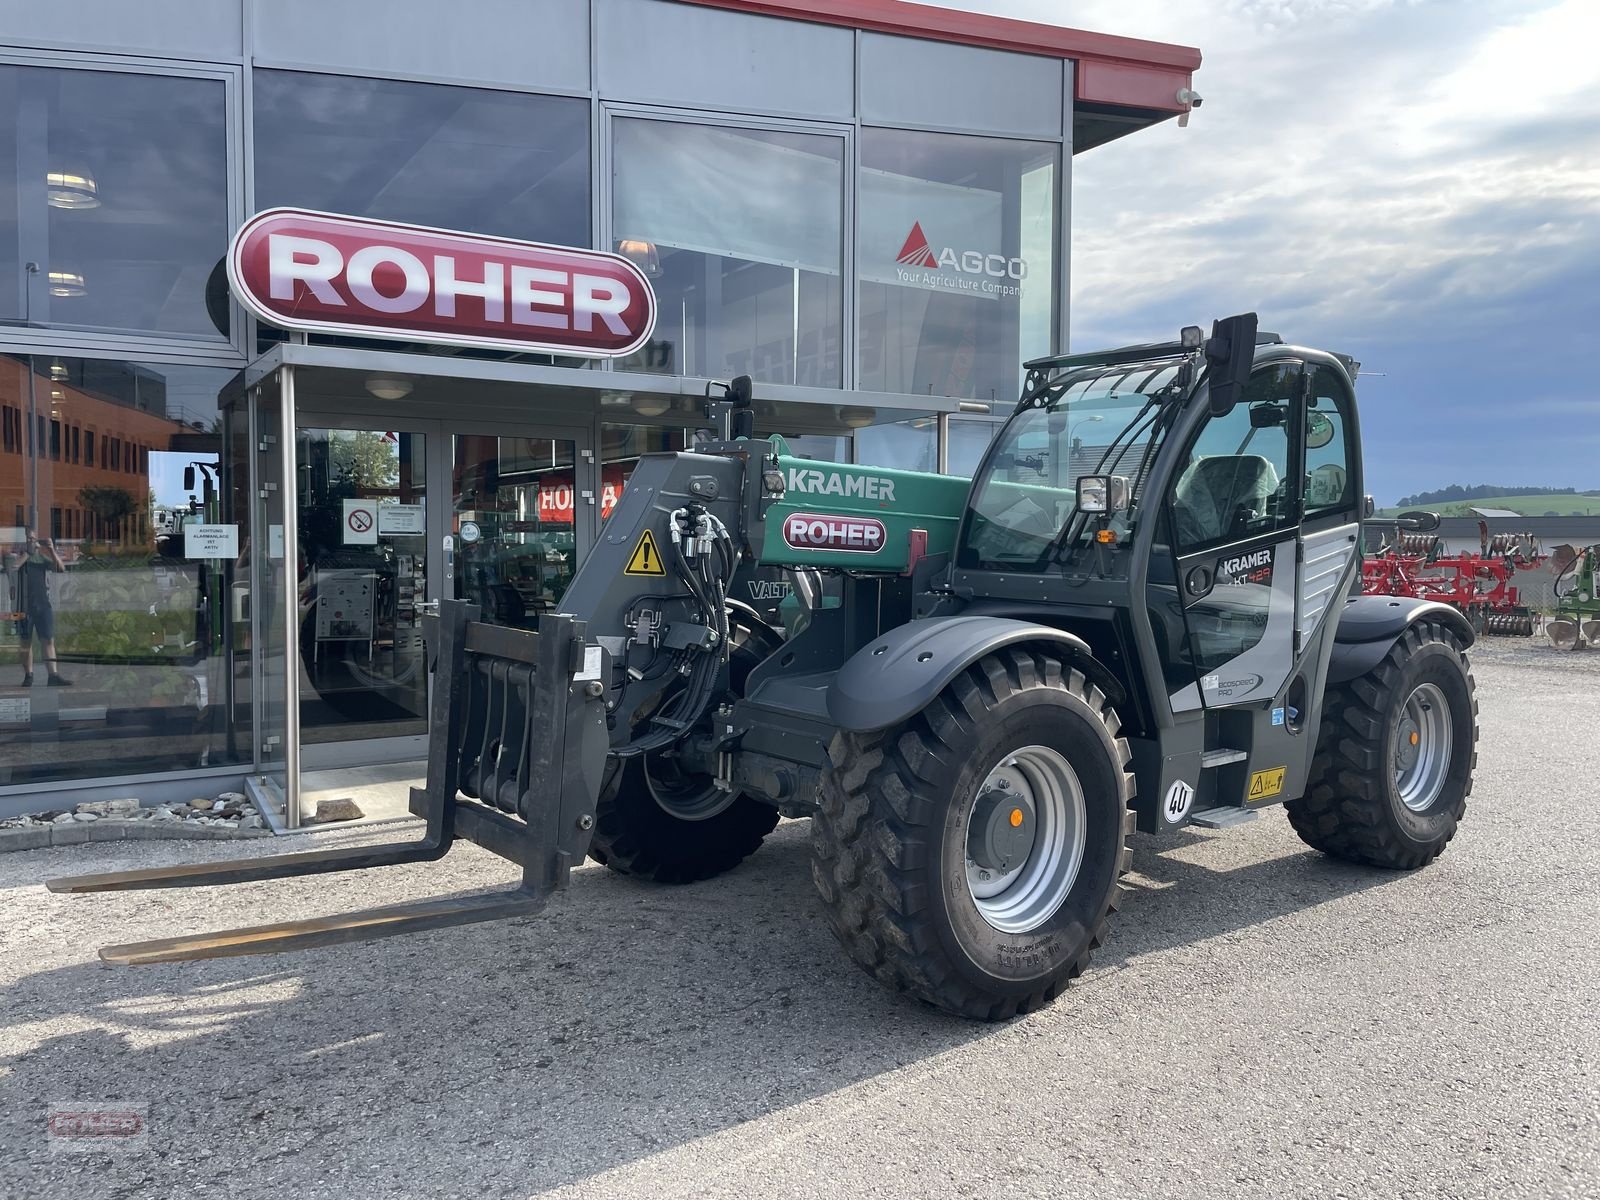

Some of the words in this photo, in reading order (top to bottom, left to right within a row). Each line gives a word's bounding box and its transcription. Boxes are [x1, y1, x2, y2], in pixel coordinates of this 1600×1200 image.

[938, 247, 1028, 280] AGCO
[268, 233, 632, 337] ROHER
[896, 268, 920, 282] Your
[922, 272, 978, 290] Agriculture
[789, 468, 896, 501] KRAMER
[789, 520, 881, 547] ROHER
[1224, 550, 1271, 575] KRAMER
[1248, 567, 1270, 582] 429
[1218, 689, 1233, 697] PRO
[1169, 786, 1187, 814] 40
